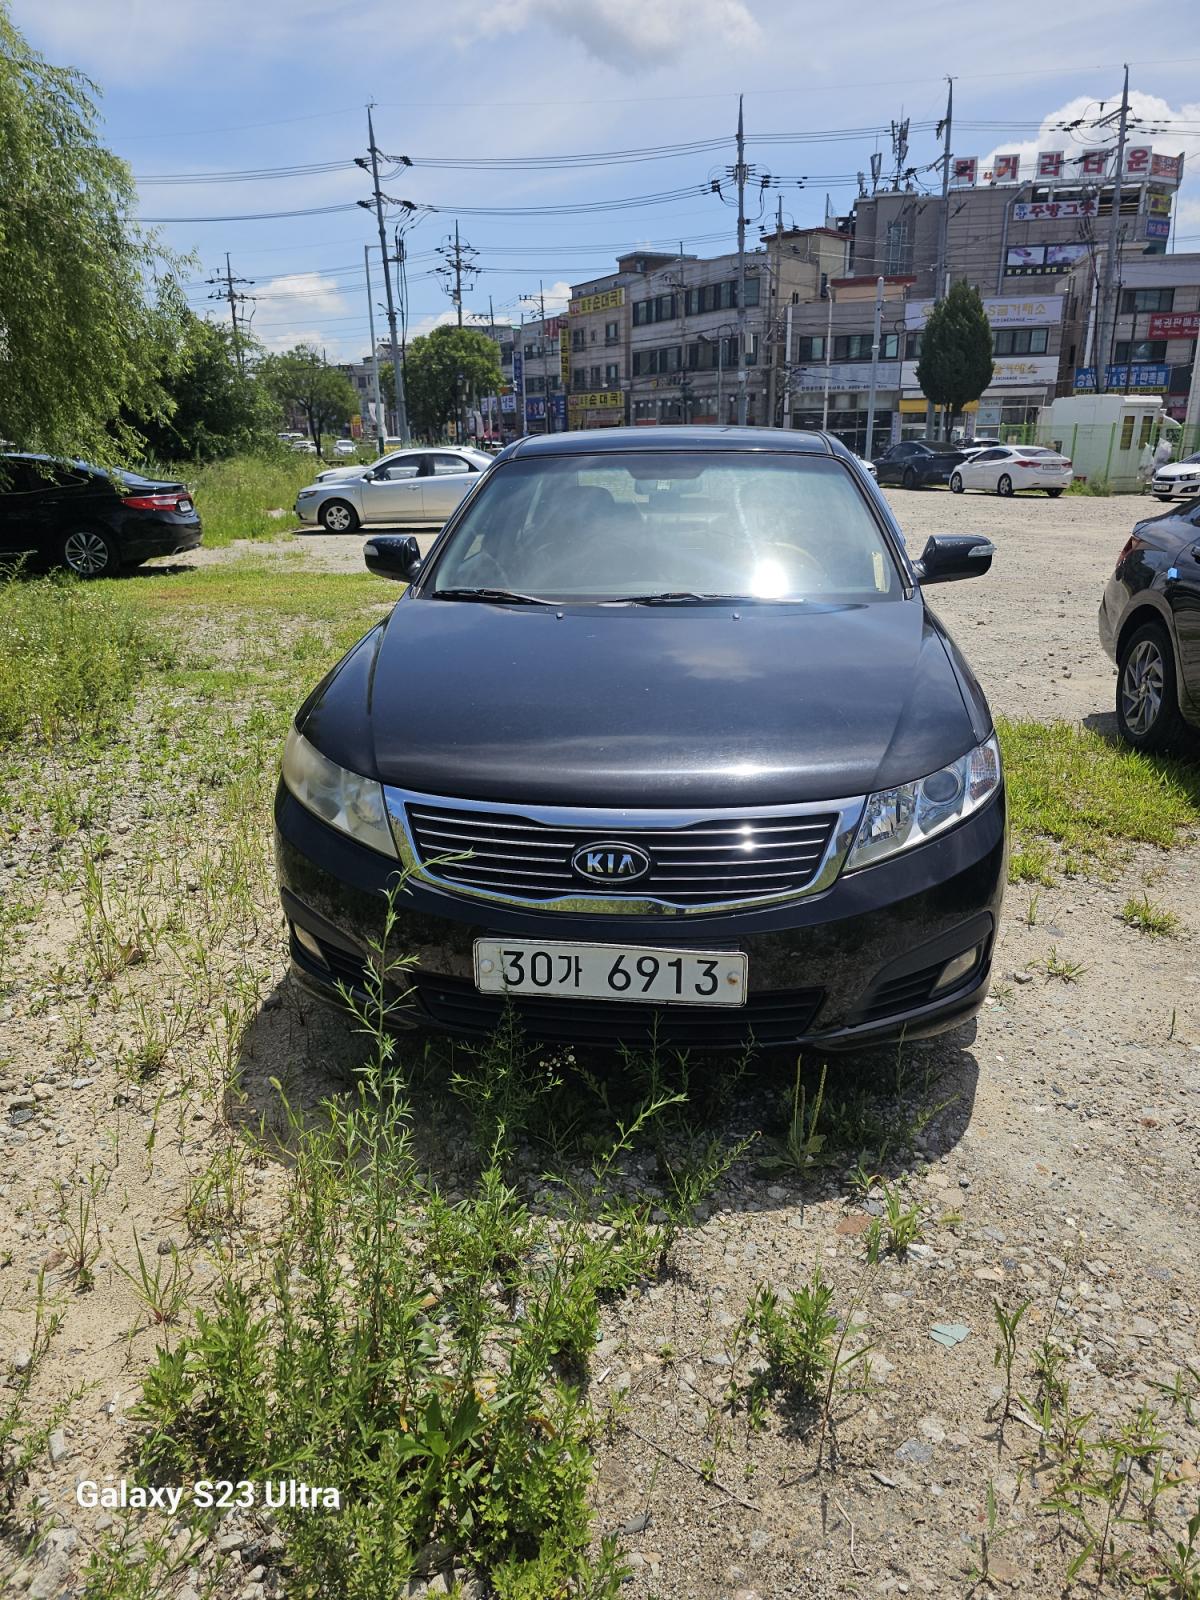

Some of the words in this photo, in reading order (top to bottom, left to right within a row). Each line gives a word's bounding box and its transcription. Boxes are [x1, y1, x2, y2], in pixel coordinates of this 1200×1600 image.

[586, 853, 636, 874] KIA
[503, 950, 583, 988] 30가
[607, 954, 719, 996] 6913
